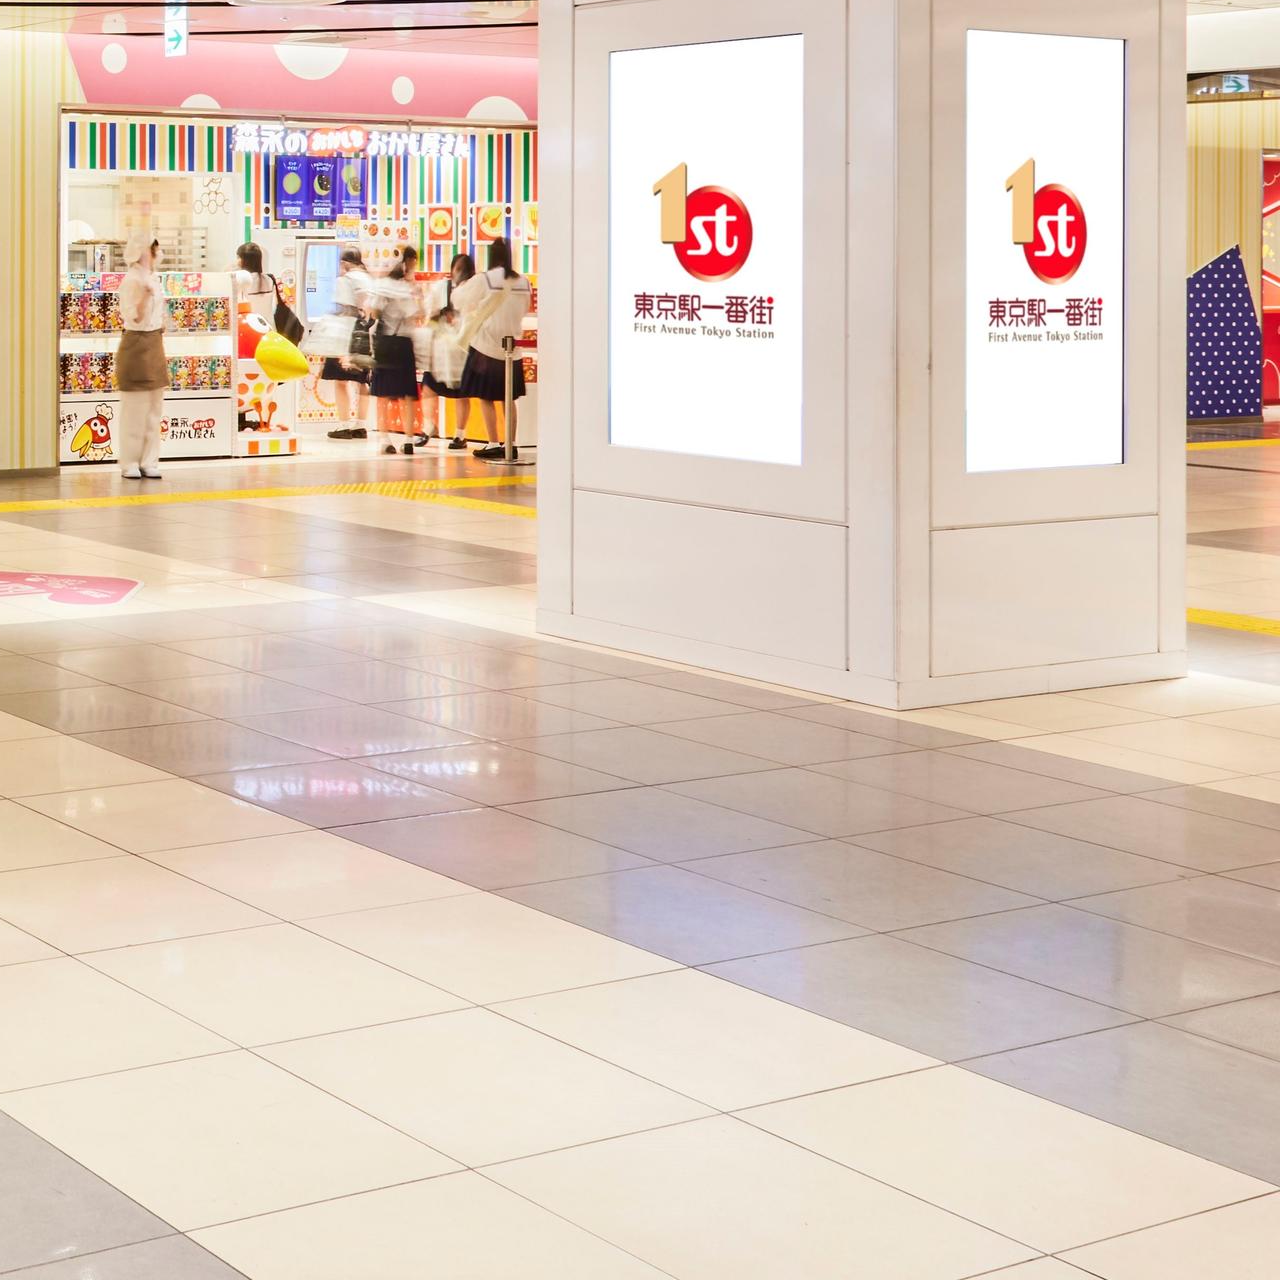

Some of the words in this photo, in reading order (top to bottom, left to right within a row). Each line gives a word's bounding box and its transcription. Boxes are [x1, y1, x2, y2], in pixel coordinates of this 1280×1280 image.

[652, 161, 739, 257] 1st
[1005, 157, 1076, 258] 1st
[634, 292, 774, 325] 東京駅一番街
[989, 297, 1103, 327] 東京駅一番街
[634, 323, 656, 333] First
[660, 324, 697, 335] Avenue
[701, 326, 732, 339] Tokyo
[735, 327, 775, 339] Station
[988, 332, 1008, 342] First
[1012, 332, 1042, 342] Avenue
[1046, 331, 1071, 343] Tokyo
[1074, 330, 1104, 341] Station
